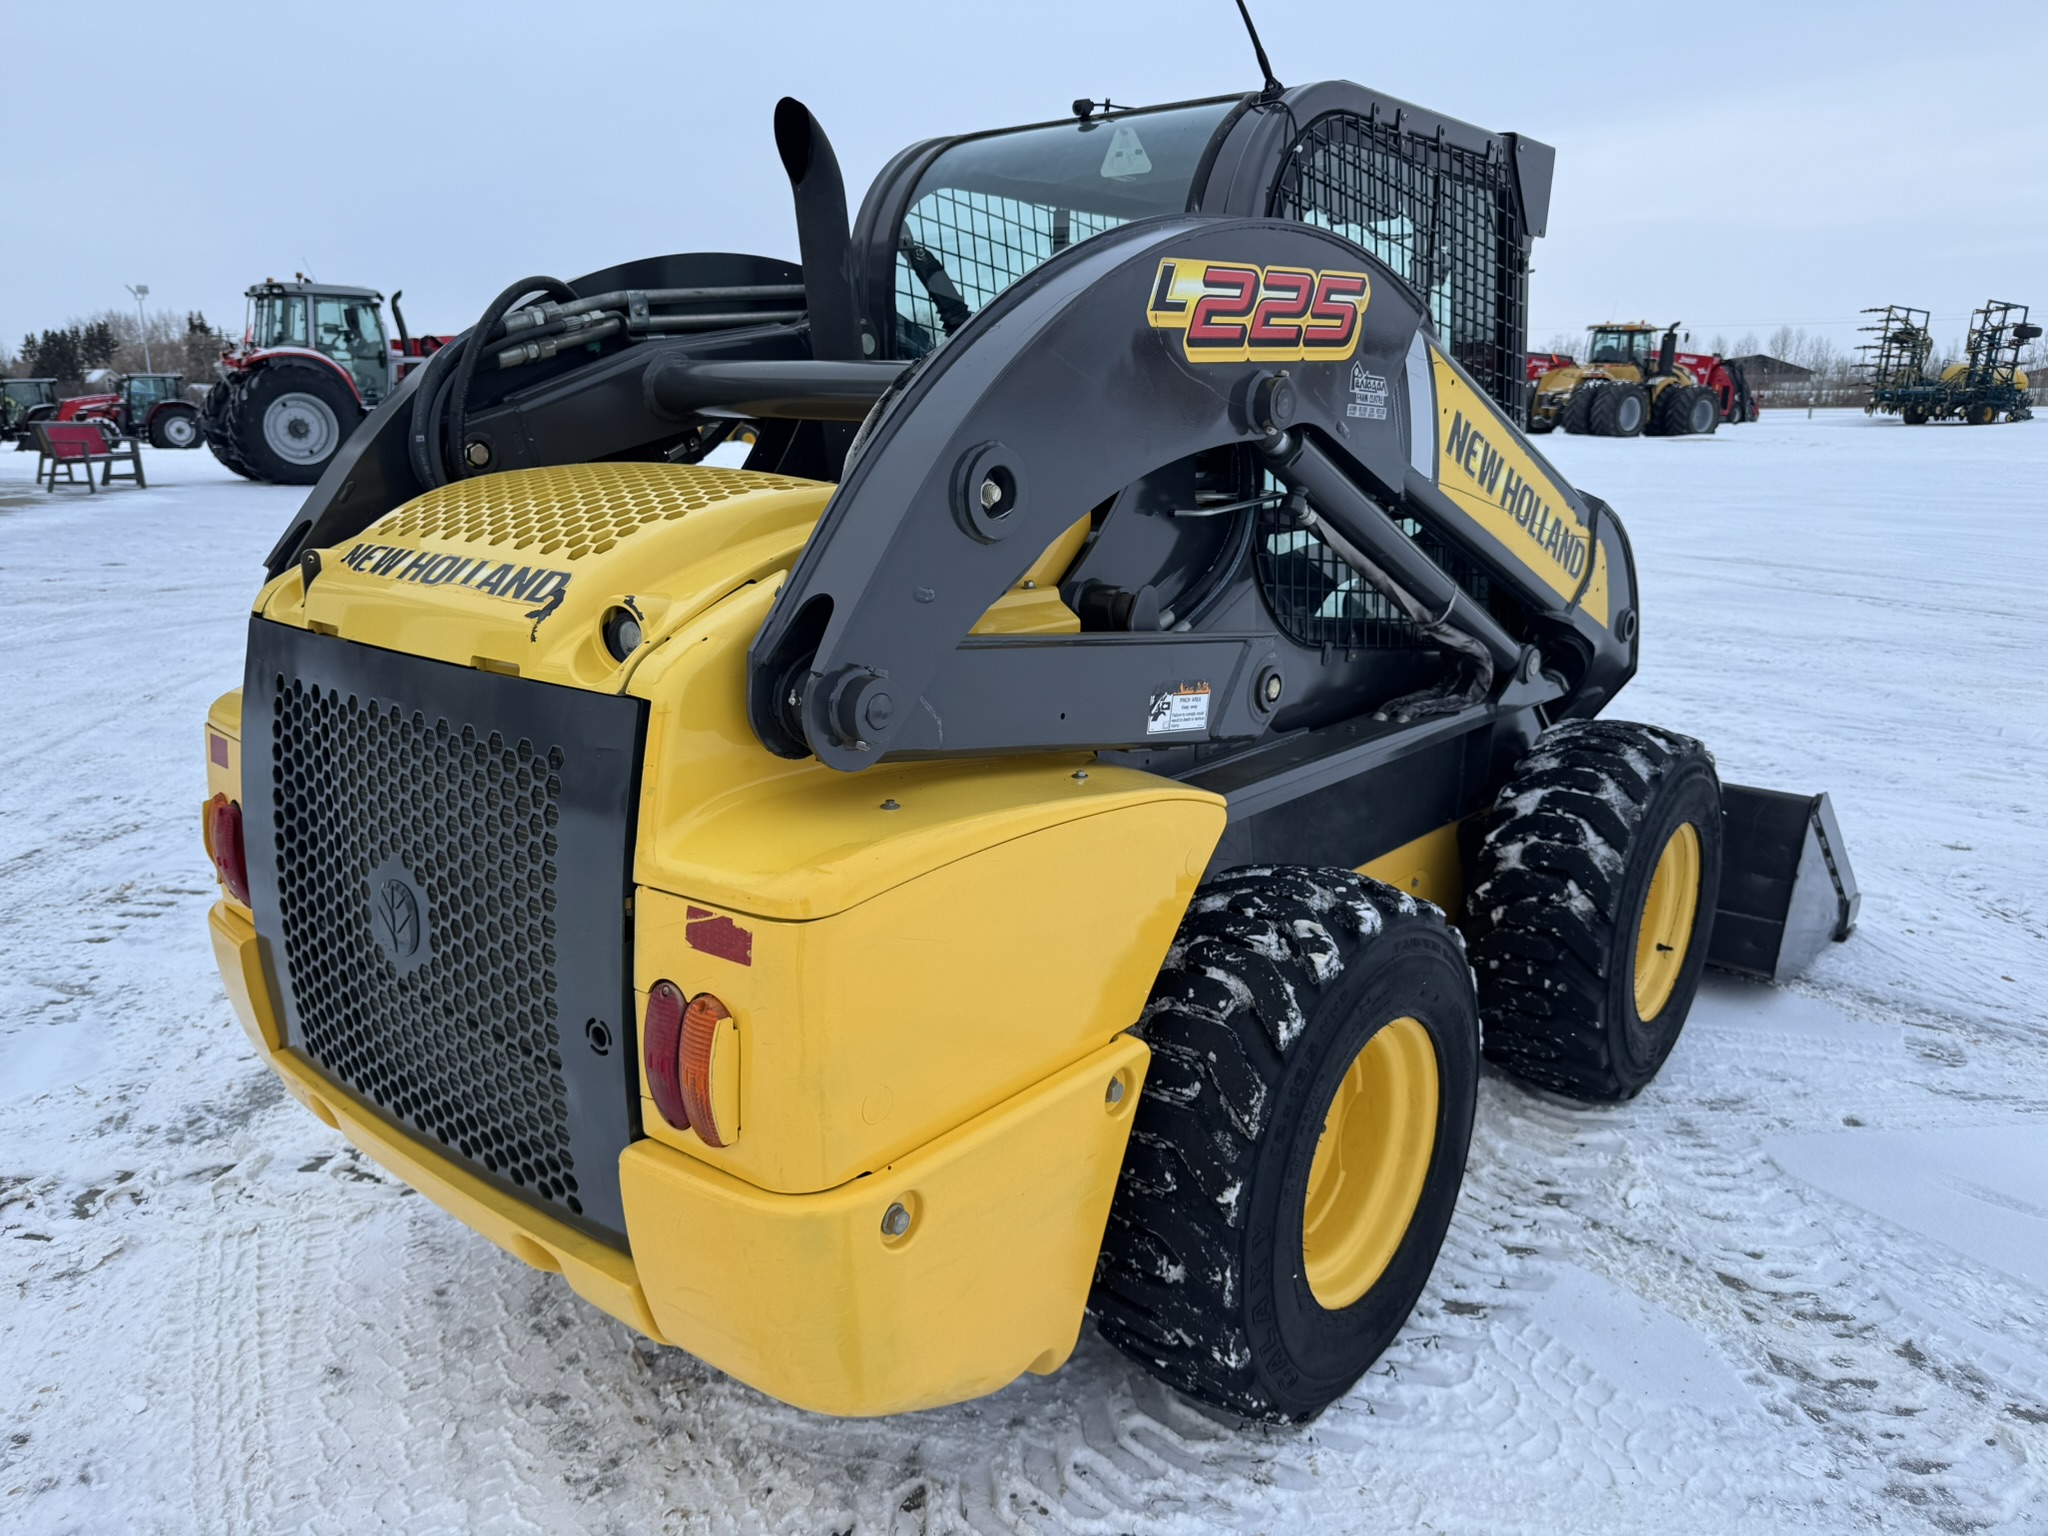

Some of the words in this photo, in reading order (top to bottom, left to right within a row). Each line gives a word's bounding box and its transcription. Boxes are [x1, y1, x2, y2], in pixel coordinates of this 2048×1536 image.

[1150, 262, 1367, 349] L225
[1445, 409, 1504, 497] NEW
[1499, 466, 1586, 581] HOLLAND
[340, 543, 415, 576] NEW
[397, 551, 572, 604] HOLLAND
[1249, 1223, 1299, 1390] GALAXY
